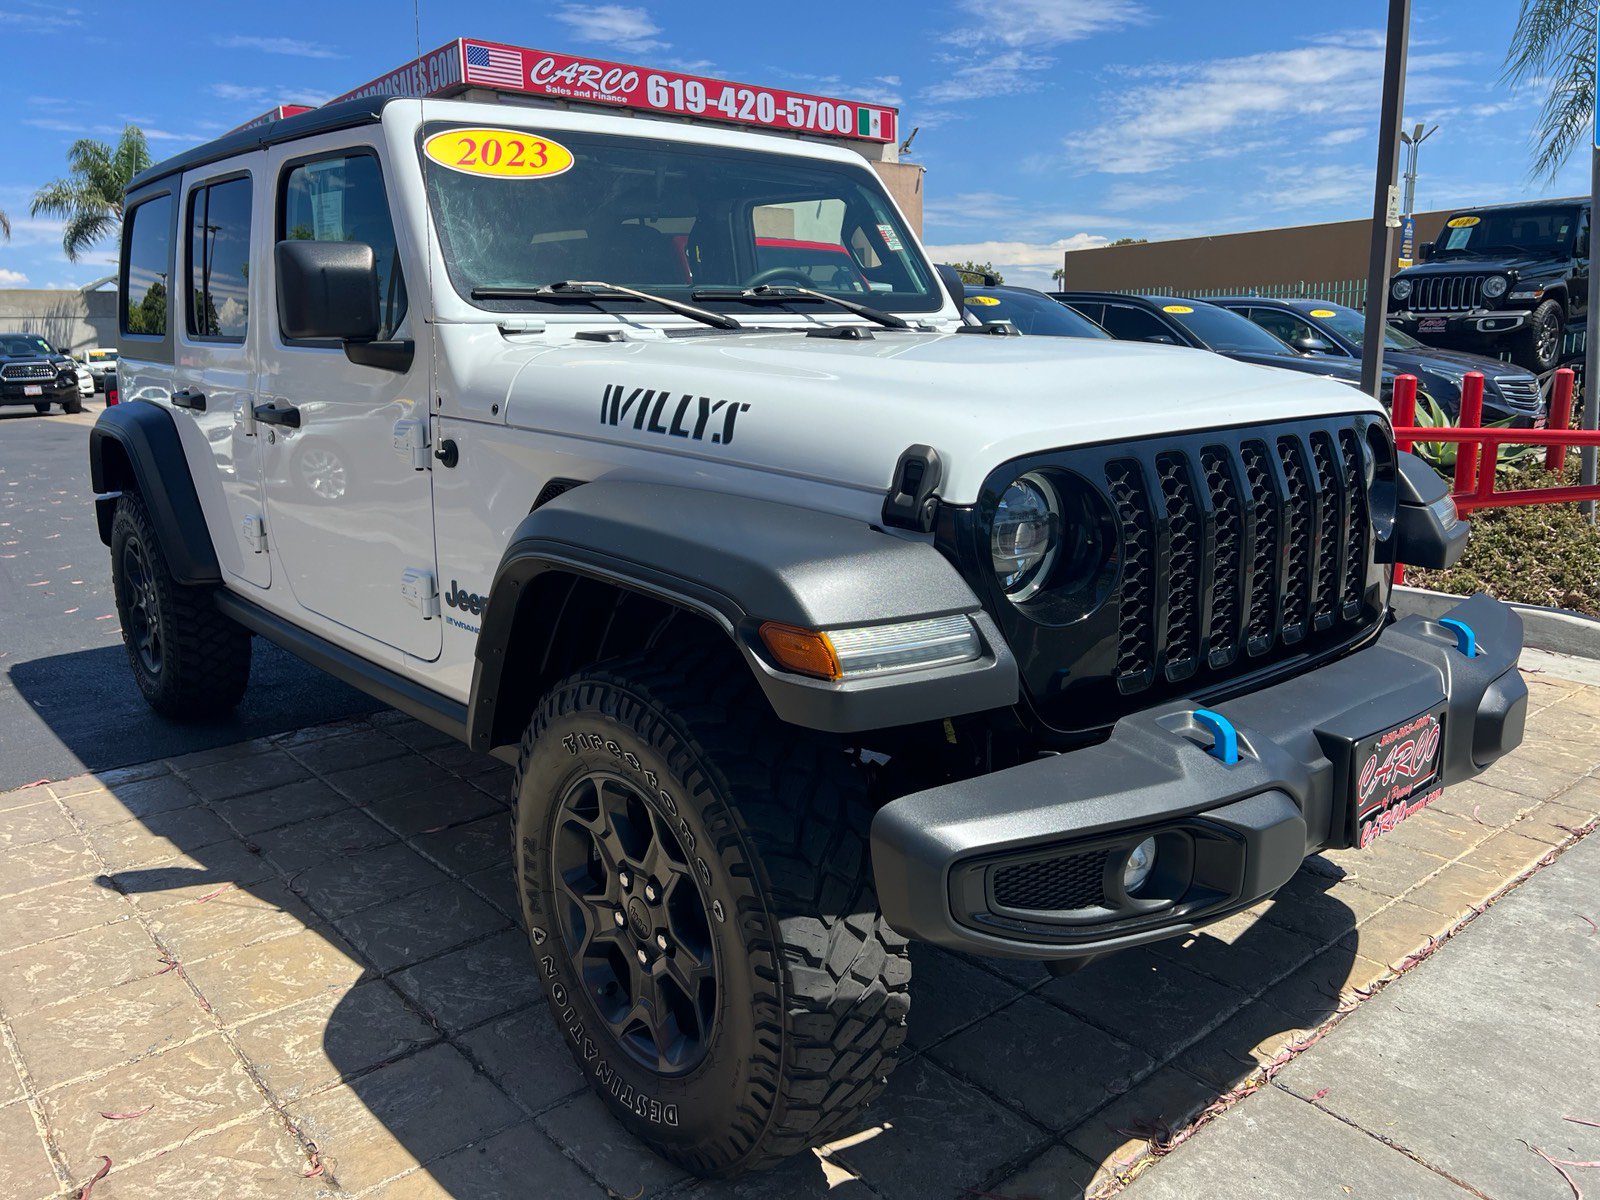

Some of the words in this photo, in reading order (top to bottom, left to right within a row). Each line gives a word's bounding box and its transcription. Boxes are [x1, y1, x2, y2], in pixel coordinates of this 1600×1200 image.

[530, 57, 639, 94] CARCO
[545, 84, 571, 95] Sales
[573, 89, 590, 98] and
[593, 92, 627, 103] Finance
[646, 74, 853, 134] 619-420-5700
[457, 138, 548, 168] 2023
[600, 384, 751, 445] WILLYS
[1358, 724, 1440, 806] CARCO
[562, 732, 711, 886] Firestone
[541, 954, 679, 1127] DESTINATION
